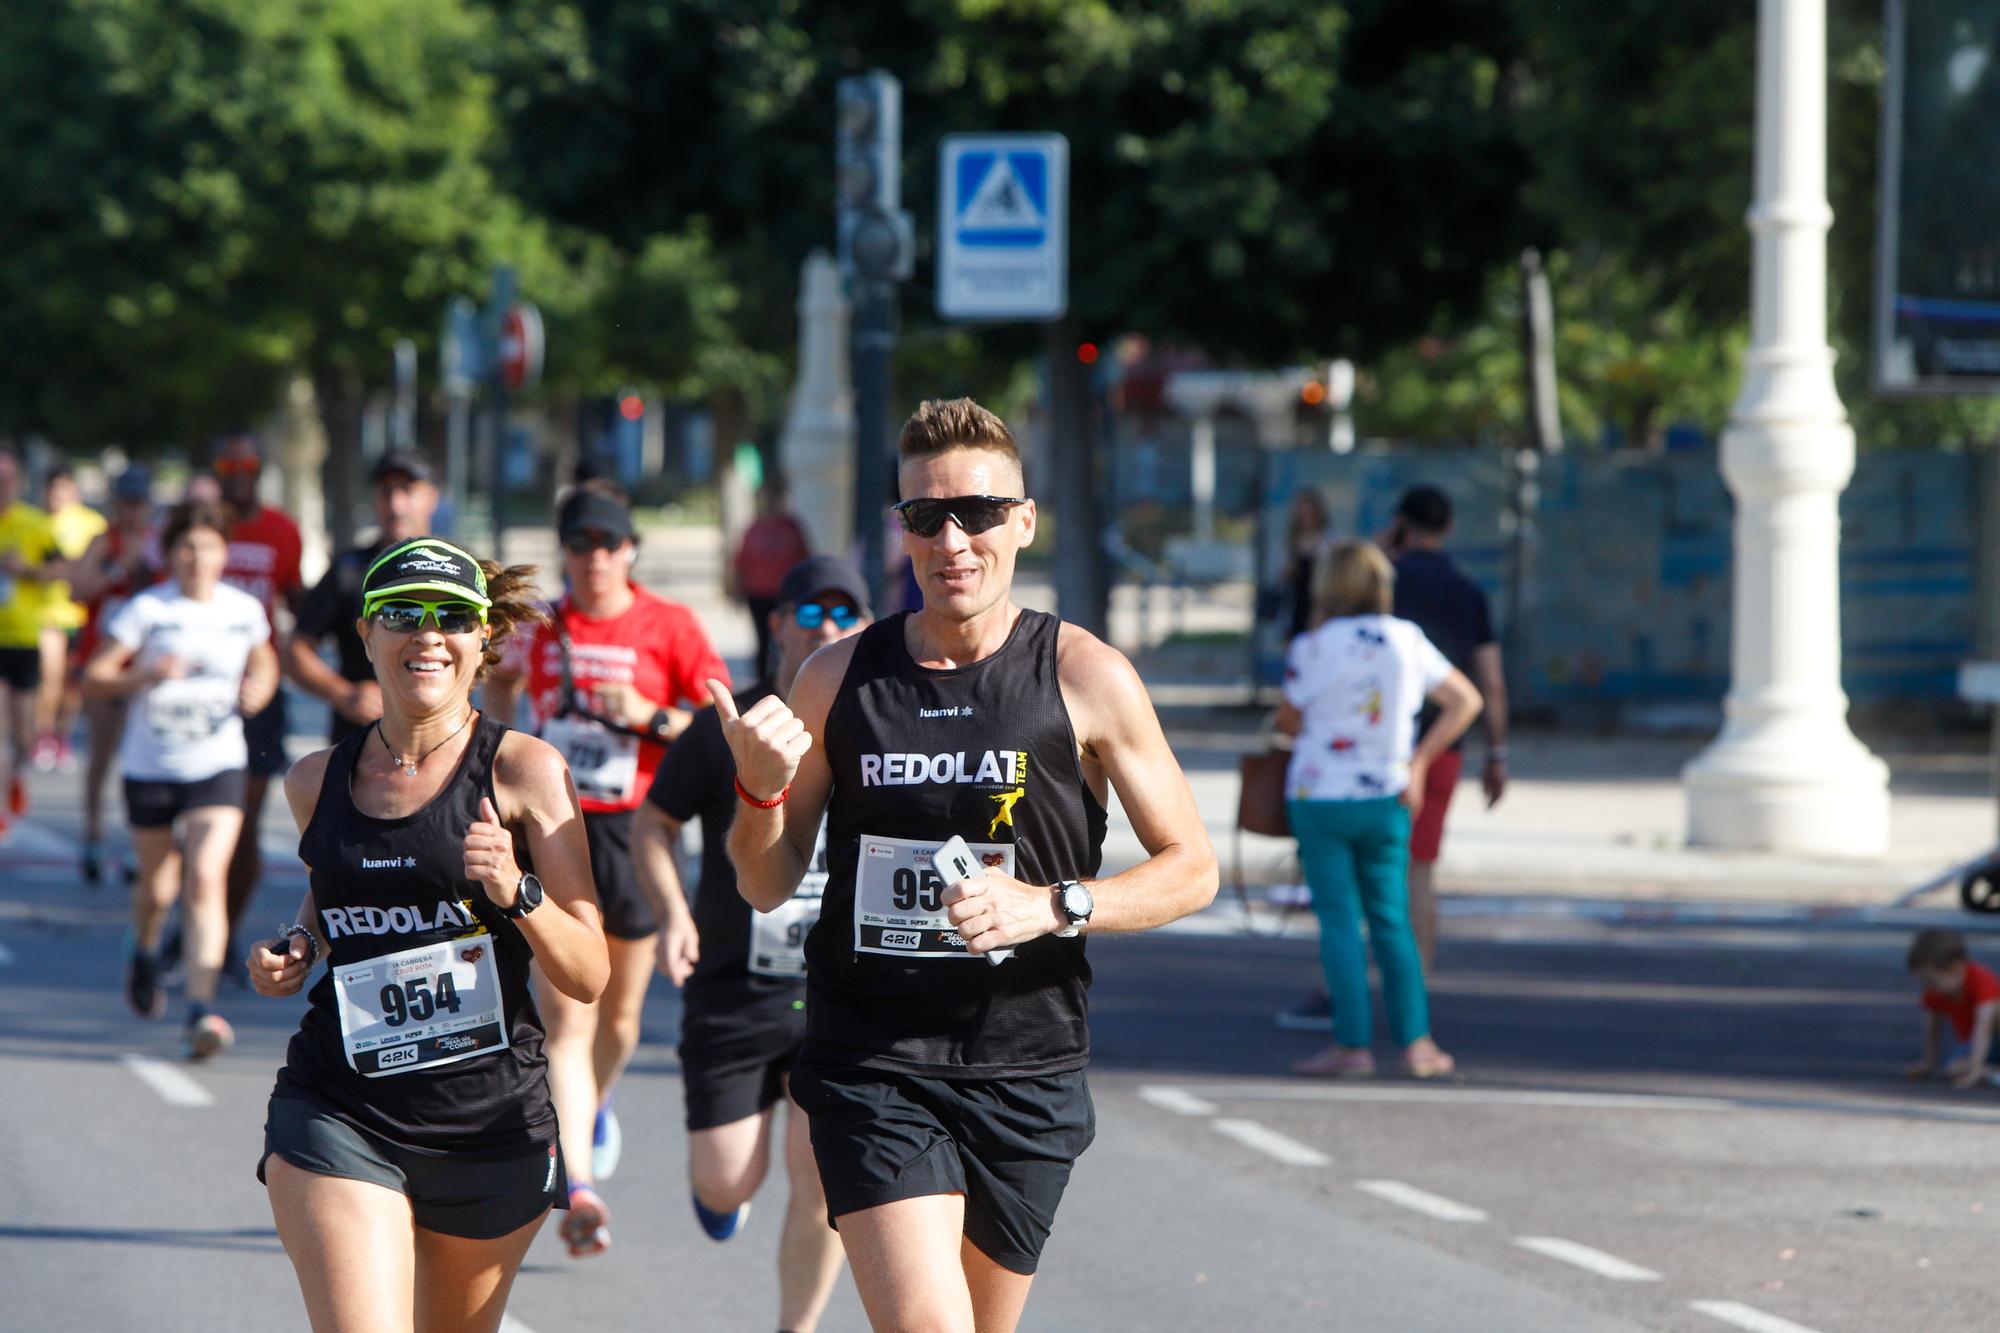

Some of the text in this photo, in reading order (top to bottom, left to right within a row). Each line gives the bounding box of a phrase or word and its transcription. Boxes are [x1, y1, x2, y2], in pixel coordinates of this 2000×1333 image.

[920, 706, 958, 718] luanvi
[861, 750, 1017, 787] REDOLAT
[1016, 752, 1028, 785] TEAM
[363, 857, 401, 868] luanvi
[893, 867, 944, 912] 95
[884, 934, 917, 945] 42K
[381, 971, 462, 1027] 954
[382, 1048, 415, 1063] 42K
